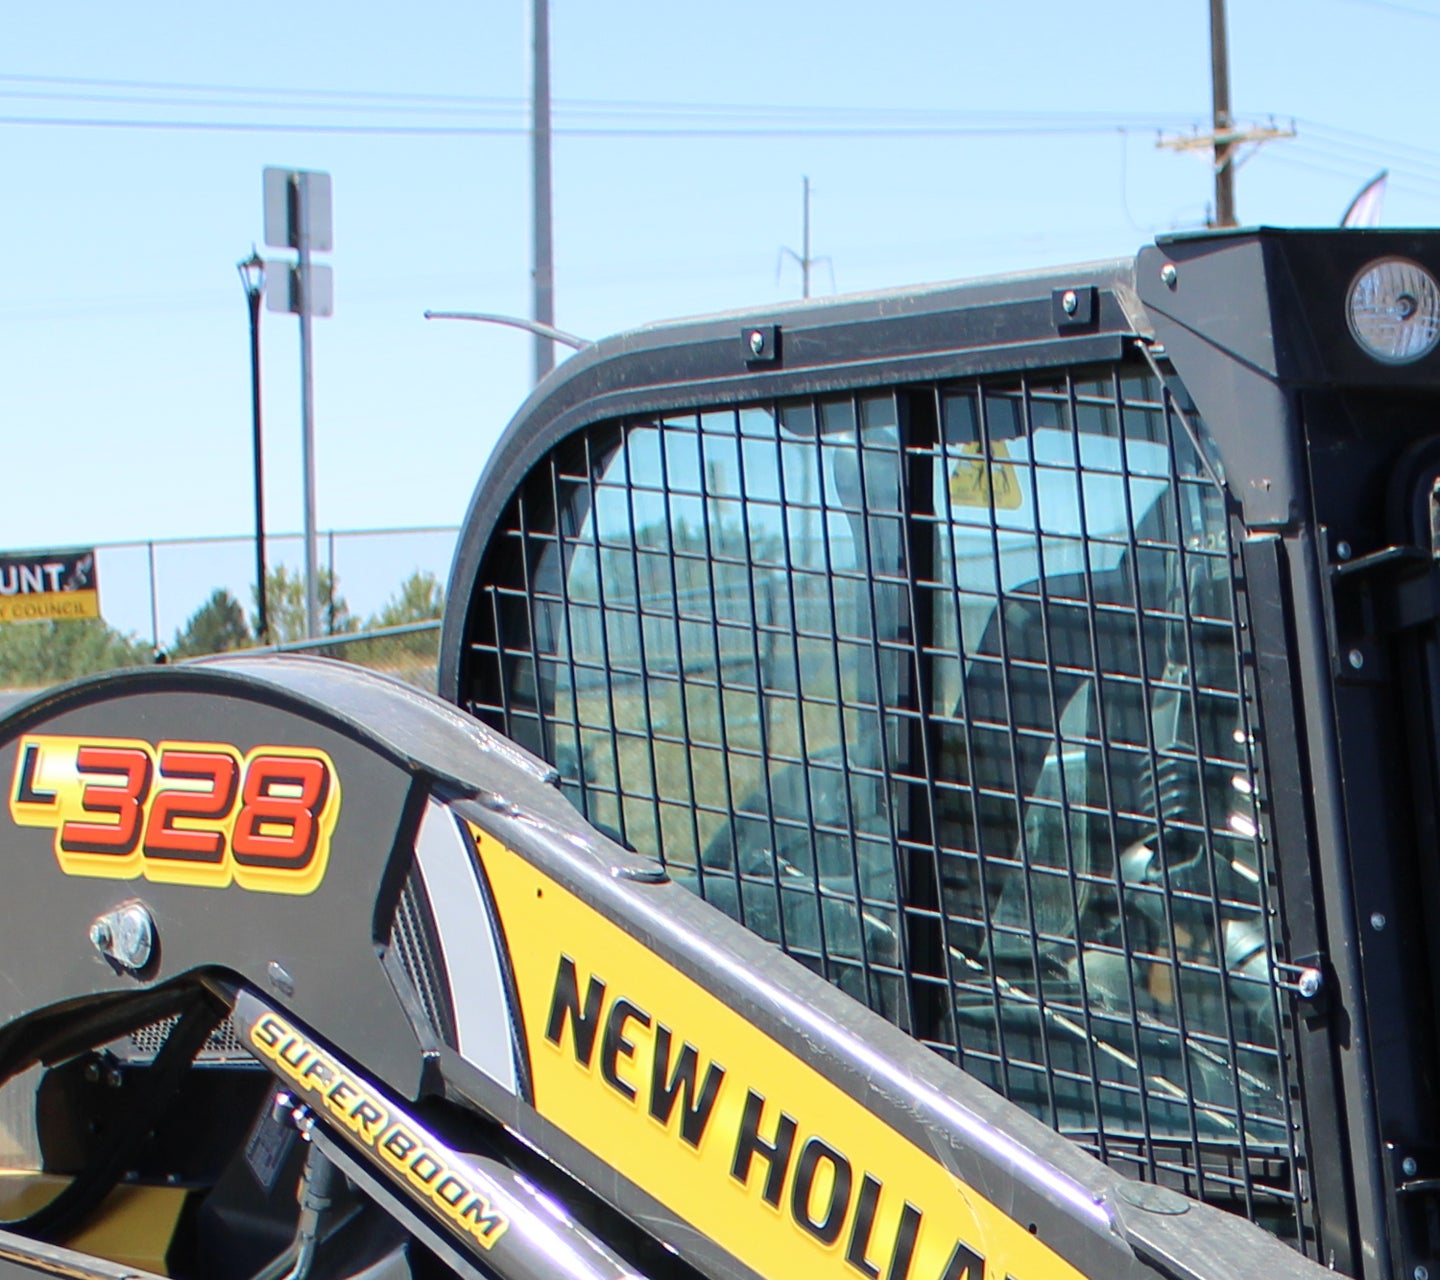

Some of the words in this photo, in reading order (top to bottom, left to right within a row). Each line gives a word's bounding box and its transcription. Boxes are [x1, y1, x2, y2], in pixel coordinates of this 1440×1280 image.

[12, 601, 86, 617] COUNCIL
[13, 739, 338, 885] L328
[543, 952, 727, 1149] NEW
